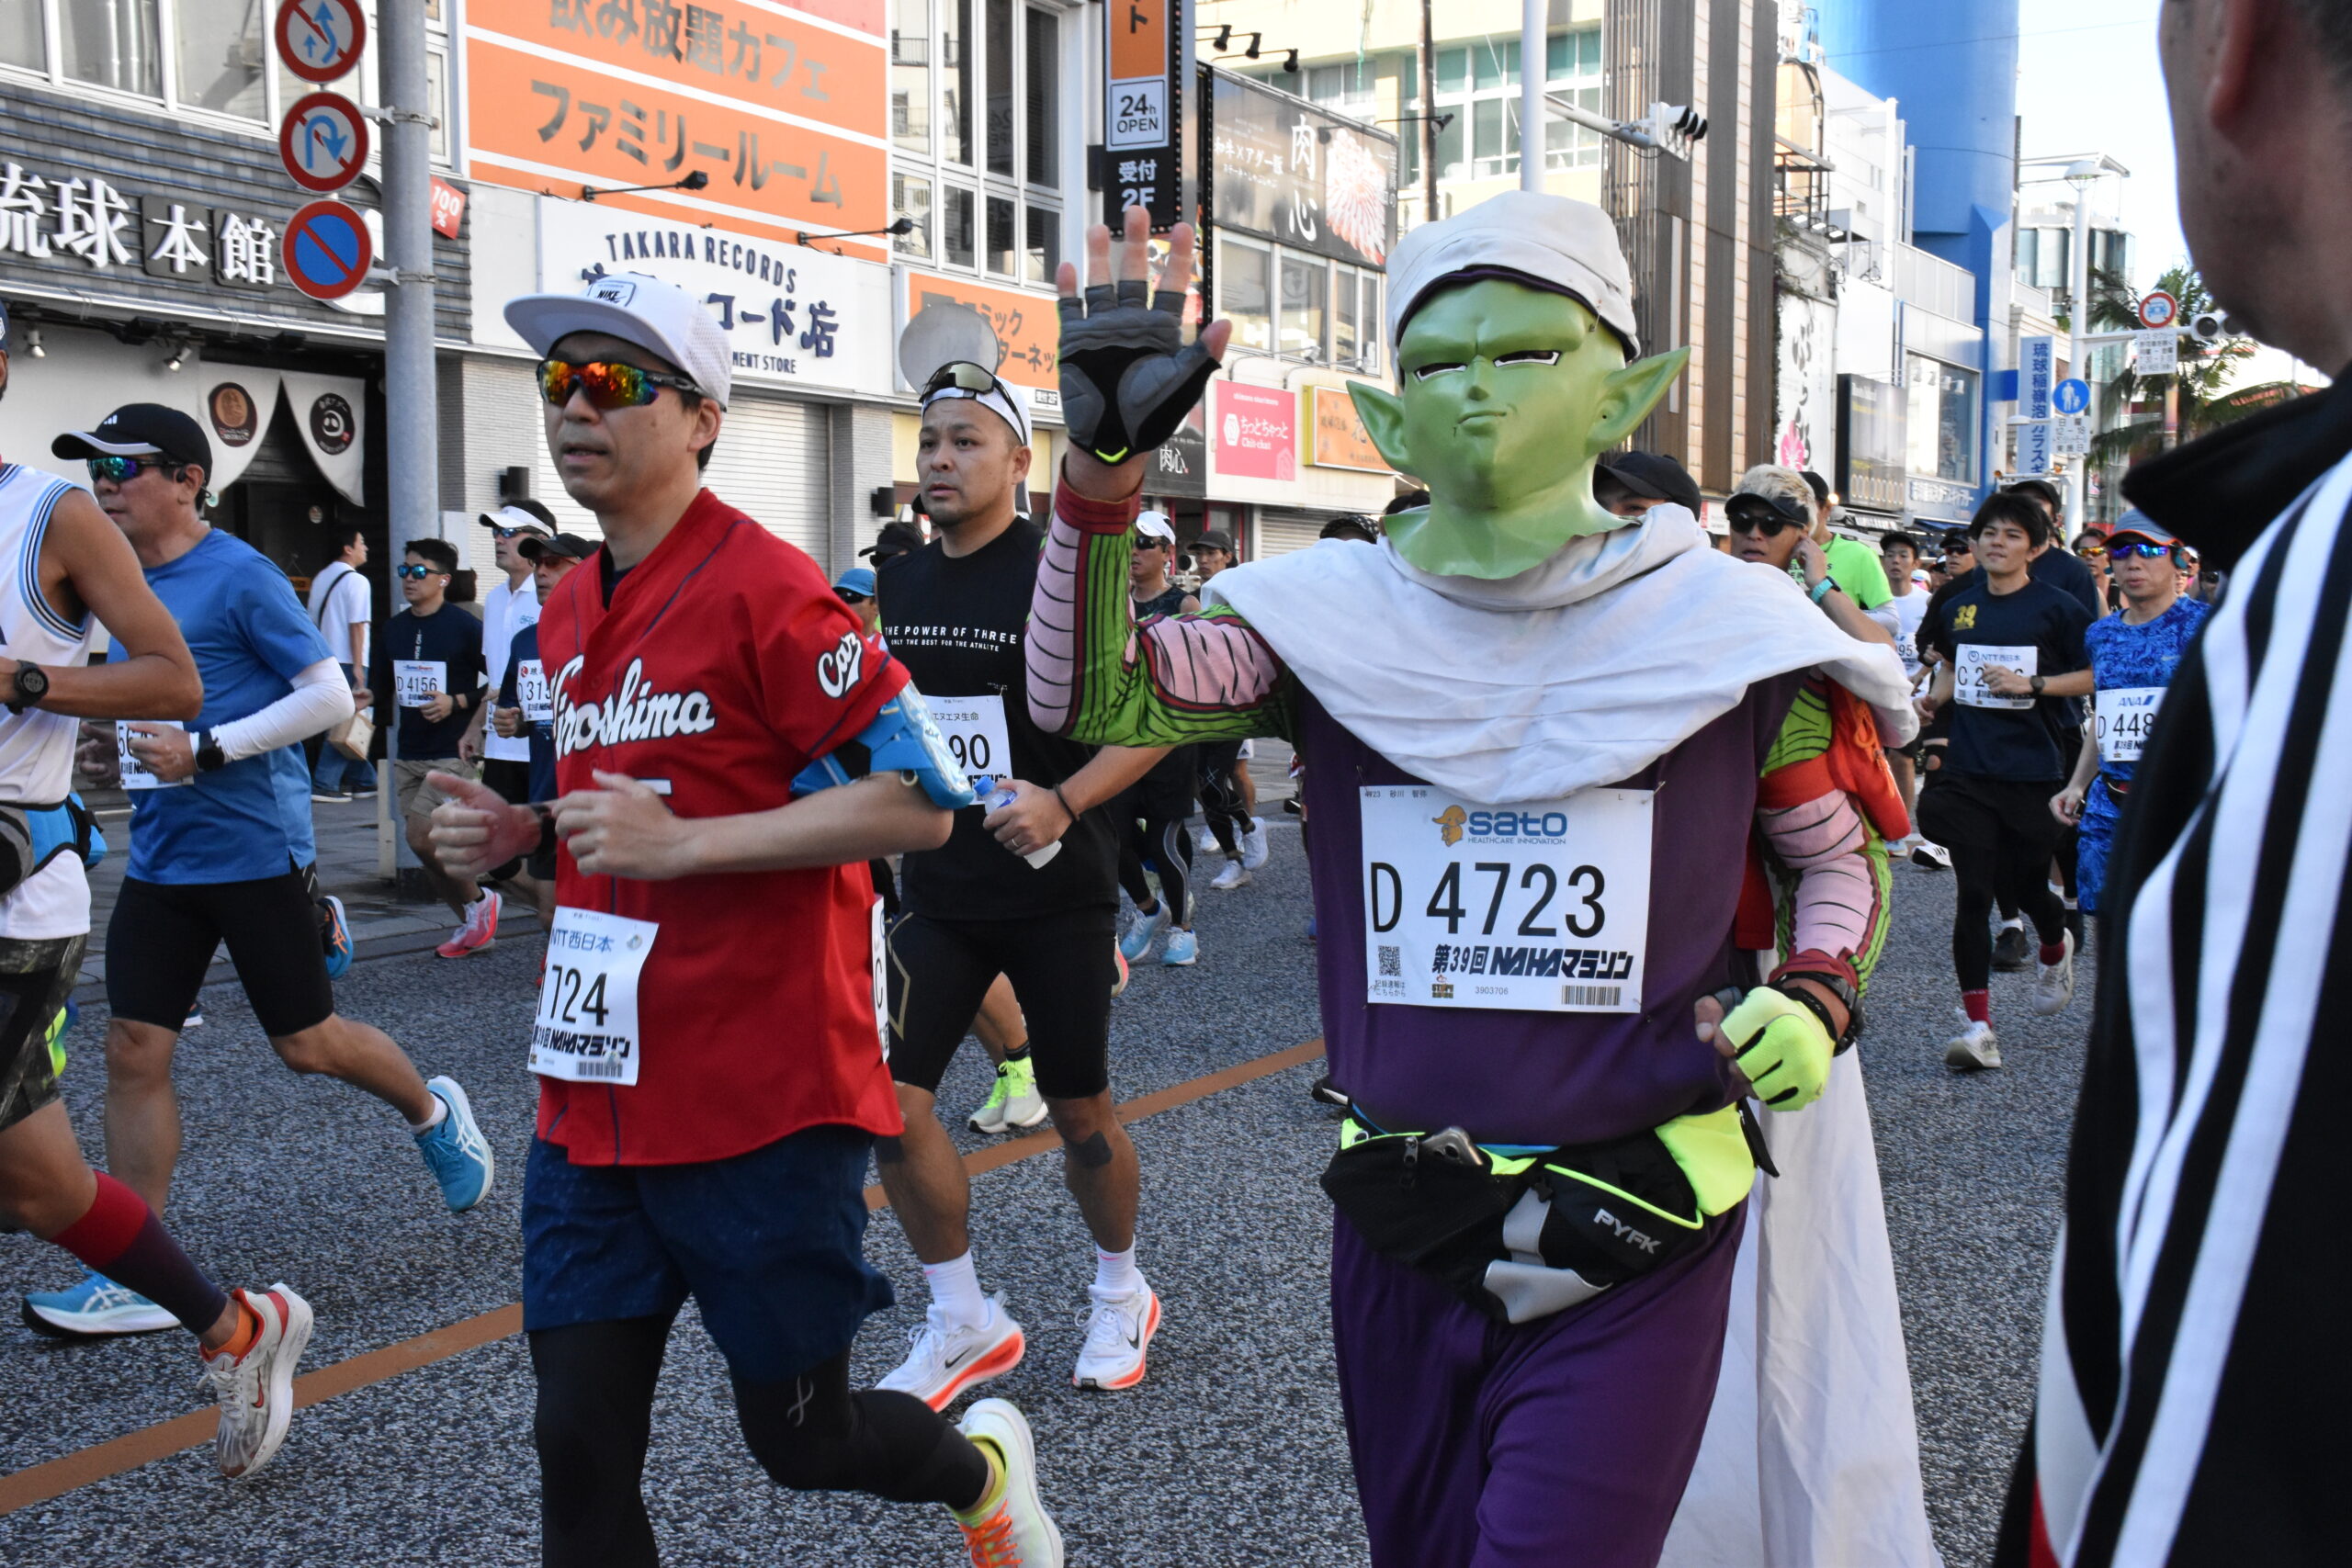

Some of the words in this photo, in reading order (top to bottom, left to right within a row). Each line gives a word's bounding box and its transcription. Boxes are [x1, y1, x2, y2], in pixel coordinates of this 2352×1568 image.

[1120, 94, 1157, 118] 24h
[1117, 118, 1159, 133] OPEN
[530, 79, 843, 209] ファミリールーム
[1118, 159, 1157, 184] 受付
[1121, 187, 1156, 213] 2F
[606, 231, 695, 262] TAKARA
[705, 236, 797, 294] RECORDS
[597, 289, 621, 301] NIKE
[763, 355, 797, 374] STORE
[885, 626, 899, 636] THE
[904, 626, 946, 637] POWER
[953, 626, 967, 637] OF
[974, 628, 1017, 645] THREE
[397, 676, 404, 692] D
[407, 676, 437, 693] 4156
[1958, 666, 1968, 686] C
[2098, 715, 2106, 739] D
[1468, 811, 1567, 837] sato
[1518, 837, 1567, 845] INNOVATION
[1370, 862, 1403, 933] D
[1426, 862, 1606, 938] 4723
[1474, 986, 1510, 996] 3903706
[1593, 1208, 1662, 1255] PYFK
